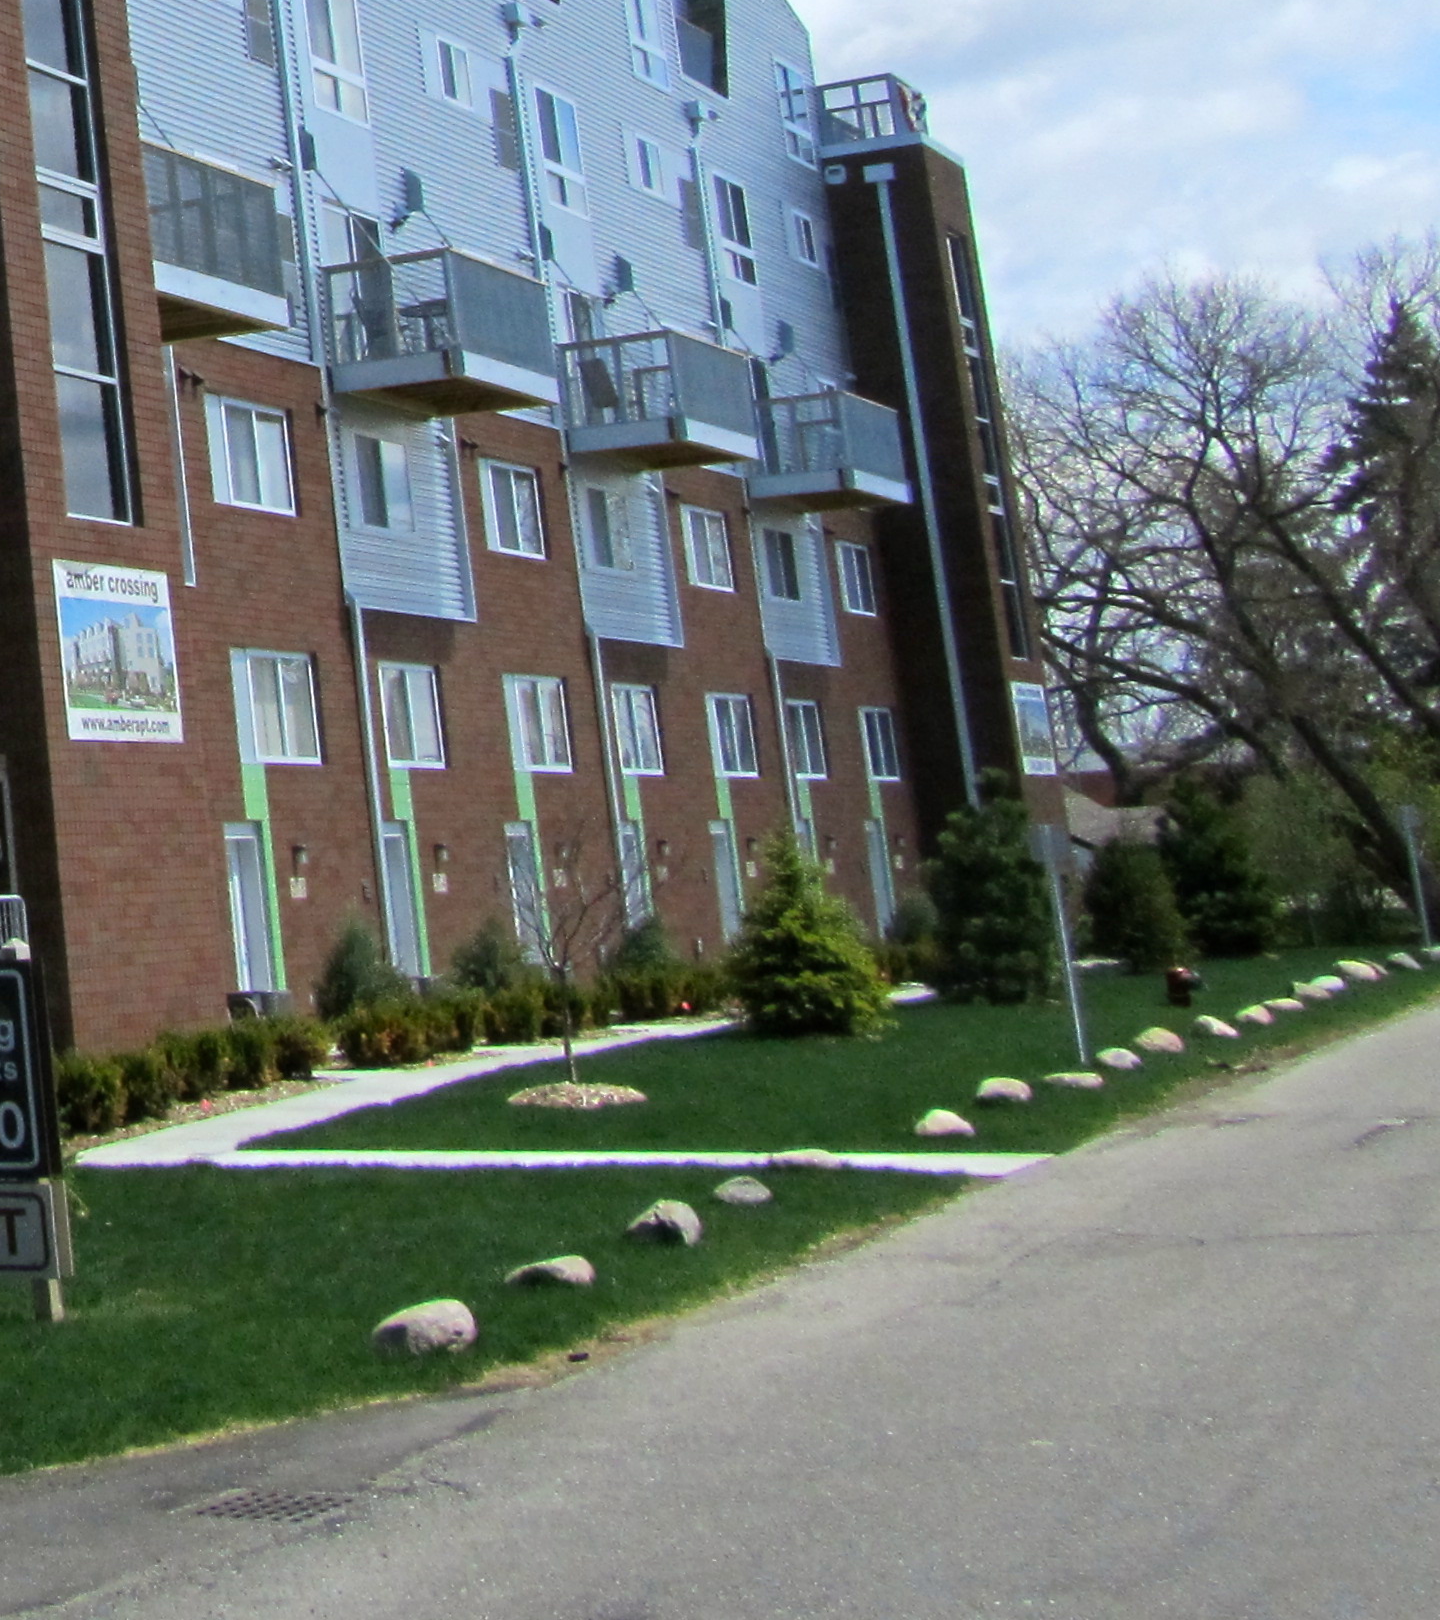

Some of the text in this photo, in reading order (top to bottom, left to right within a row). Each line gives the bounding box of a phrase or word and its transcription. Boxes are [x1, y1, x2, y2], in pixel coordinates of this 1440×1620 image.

[66, 569, 159, 603] amber crossing
[81, 715, 170, 736] www.amberapt.com
